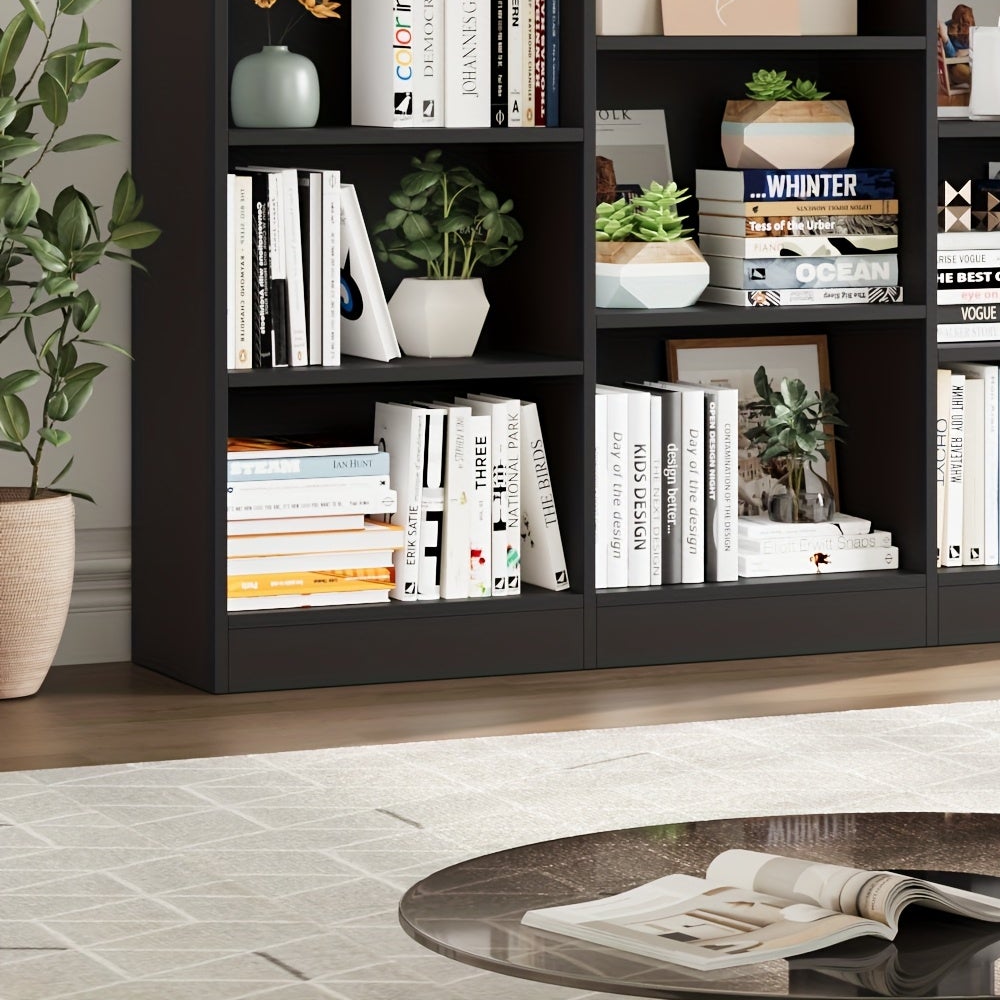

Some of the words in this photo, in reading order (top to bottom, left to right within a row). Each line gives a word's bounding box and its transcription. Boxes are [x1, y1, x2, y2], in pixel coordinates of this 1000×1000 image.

[393, 16, 412, 80] color
[462, 16, 479, 98] JOHANNES
[750, 221, 772, 232] Tess
[773, 220, 785, 231] of
[787, 220, 805, 231] the
[807, 219, 835, 231] Urber
[796, 261, 890, 283] OCEAN
[959, 253, 986, 264] VOGUE
[957, 271, 992, 284] BEST
[961, 290, 981, 300] eye
[984, 290, 999, 299] on
[961, 305, 997, 321] VOGUE
[708, 402, 716, 428] OPEN
[507, 413, 519, 449] PARK
[687, 428, 700, 455] Day
[610, 431, 623, 459] Day
[708, 431, 716, 467] DESIGN
[333, 459, 348, 470] IAN
[349, 458, 373, 468] HUNT
[475, 436, 488, 490] THREE
[530, 439, 552, 491] BIRDS
[613, 464, 623, 477] of
[634, 444, 647, 482] KIDS
[663, 443, 678, 485] design
[689, 460, 700, 474] of
[507, 457, 519, 528] NATIONAL
[612, 483, 623, 506] the
[689, 480, 700, 502] the
[708, 469, 716, 501] NIGHT
[724, 492, 731, 502] OF
[408, 505, 419, 537] SATIE
[541, 496, 558, 529] THE
[634, 488, 647, 550] DESIGN
[610, 511, 623, 559] design
[687, 508, 700, 555] design
[837, 534, 876, 550] Snaps
[406, 540, 416, 566] ERIK
